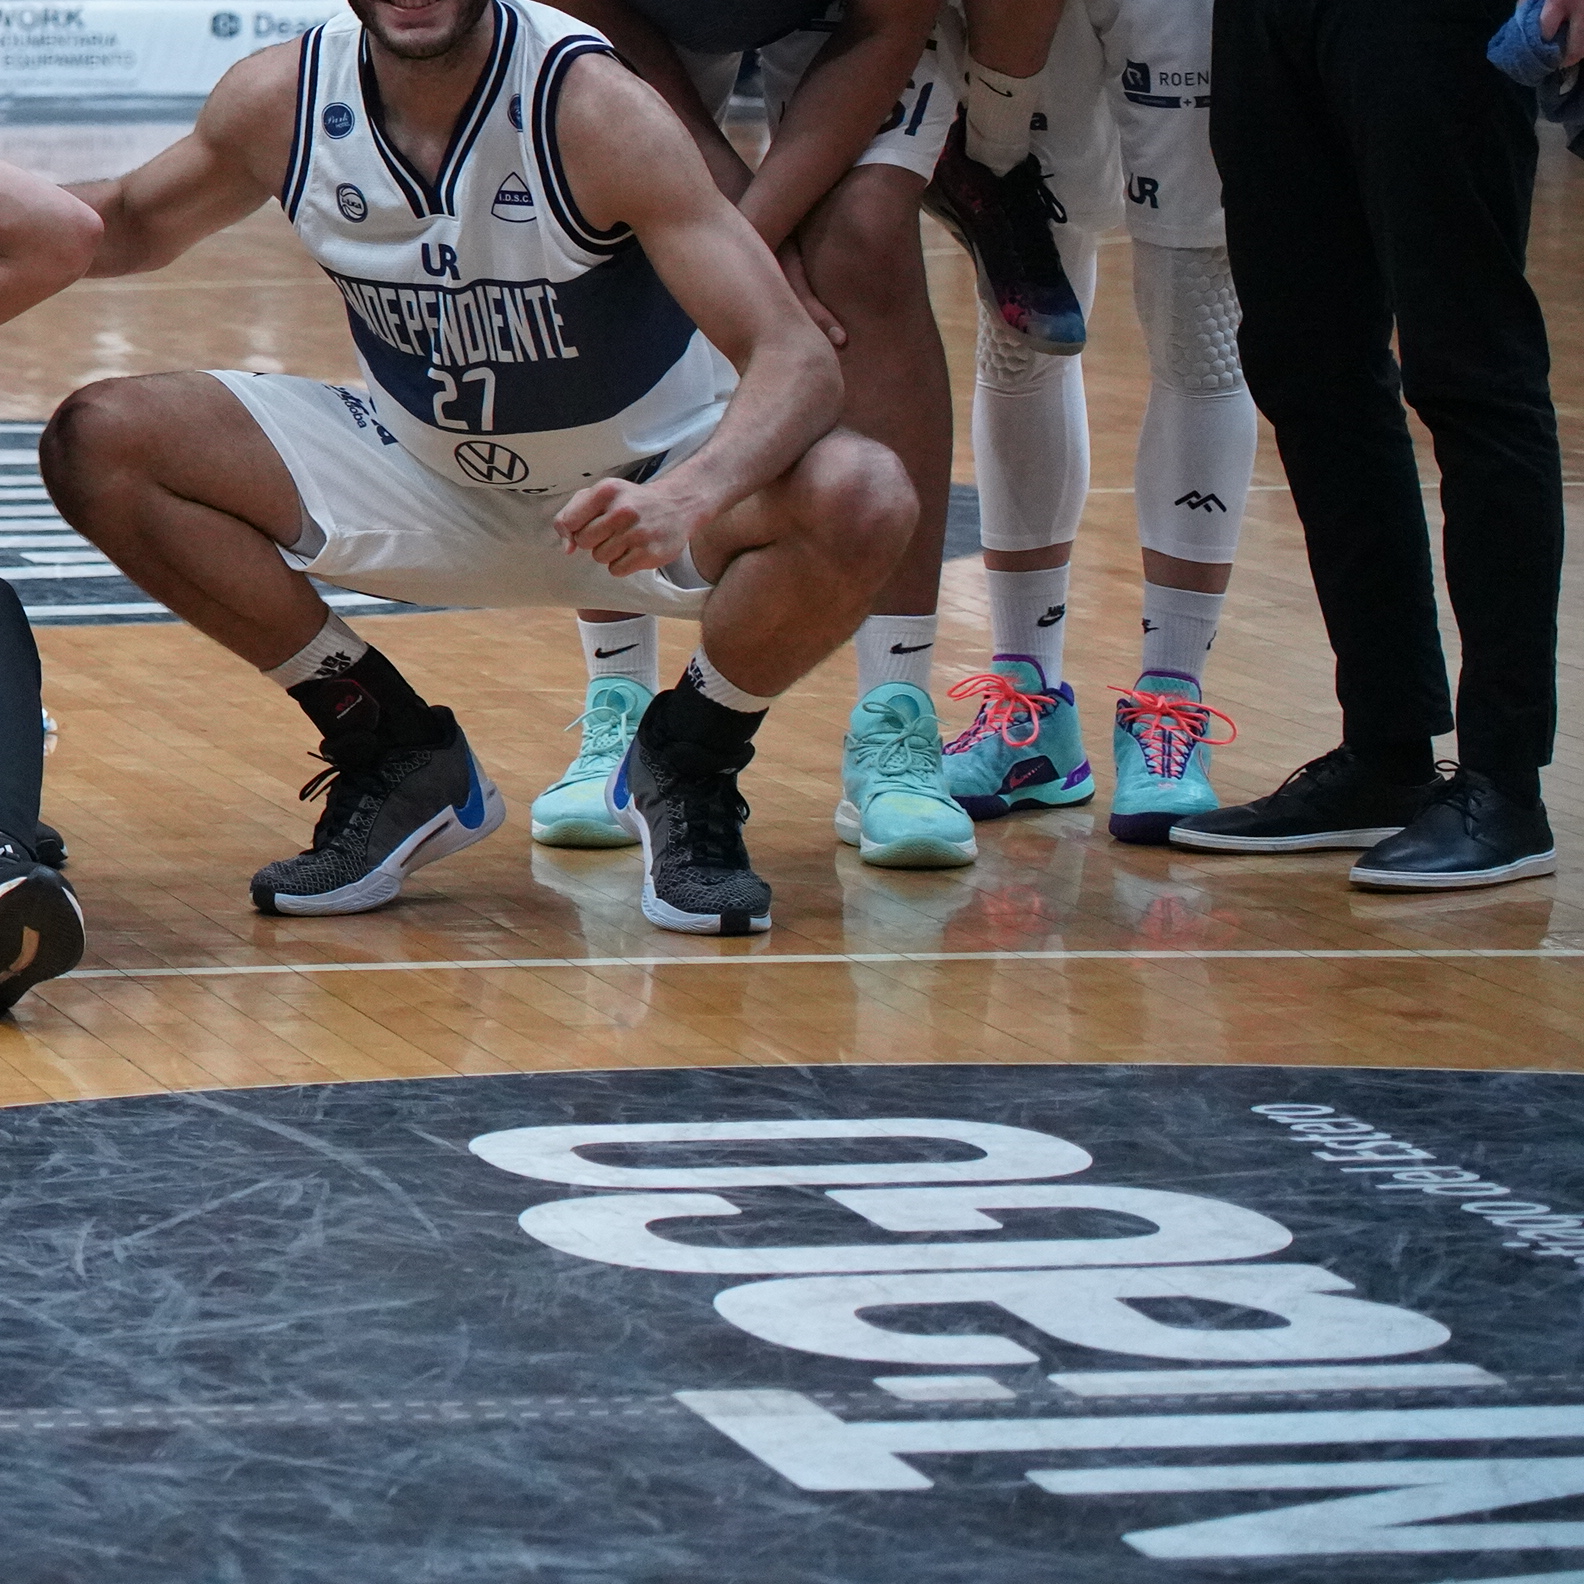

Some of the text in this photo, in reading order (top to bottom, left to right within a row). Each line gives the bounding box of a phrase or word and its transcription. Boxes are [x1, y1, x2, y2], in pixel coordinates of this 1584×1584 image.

[1159, 71, 1209, 86] ROEN
[1128, 173, 1160, 210] UR
[420, 242, 460, 281] UR
[425, 367, 497, 433] 27
